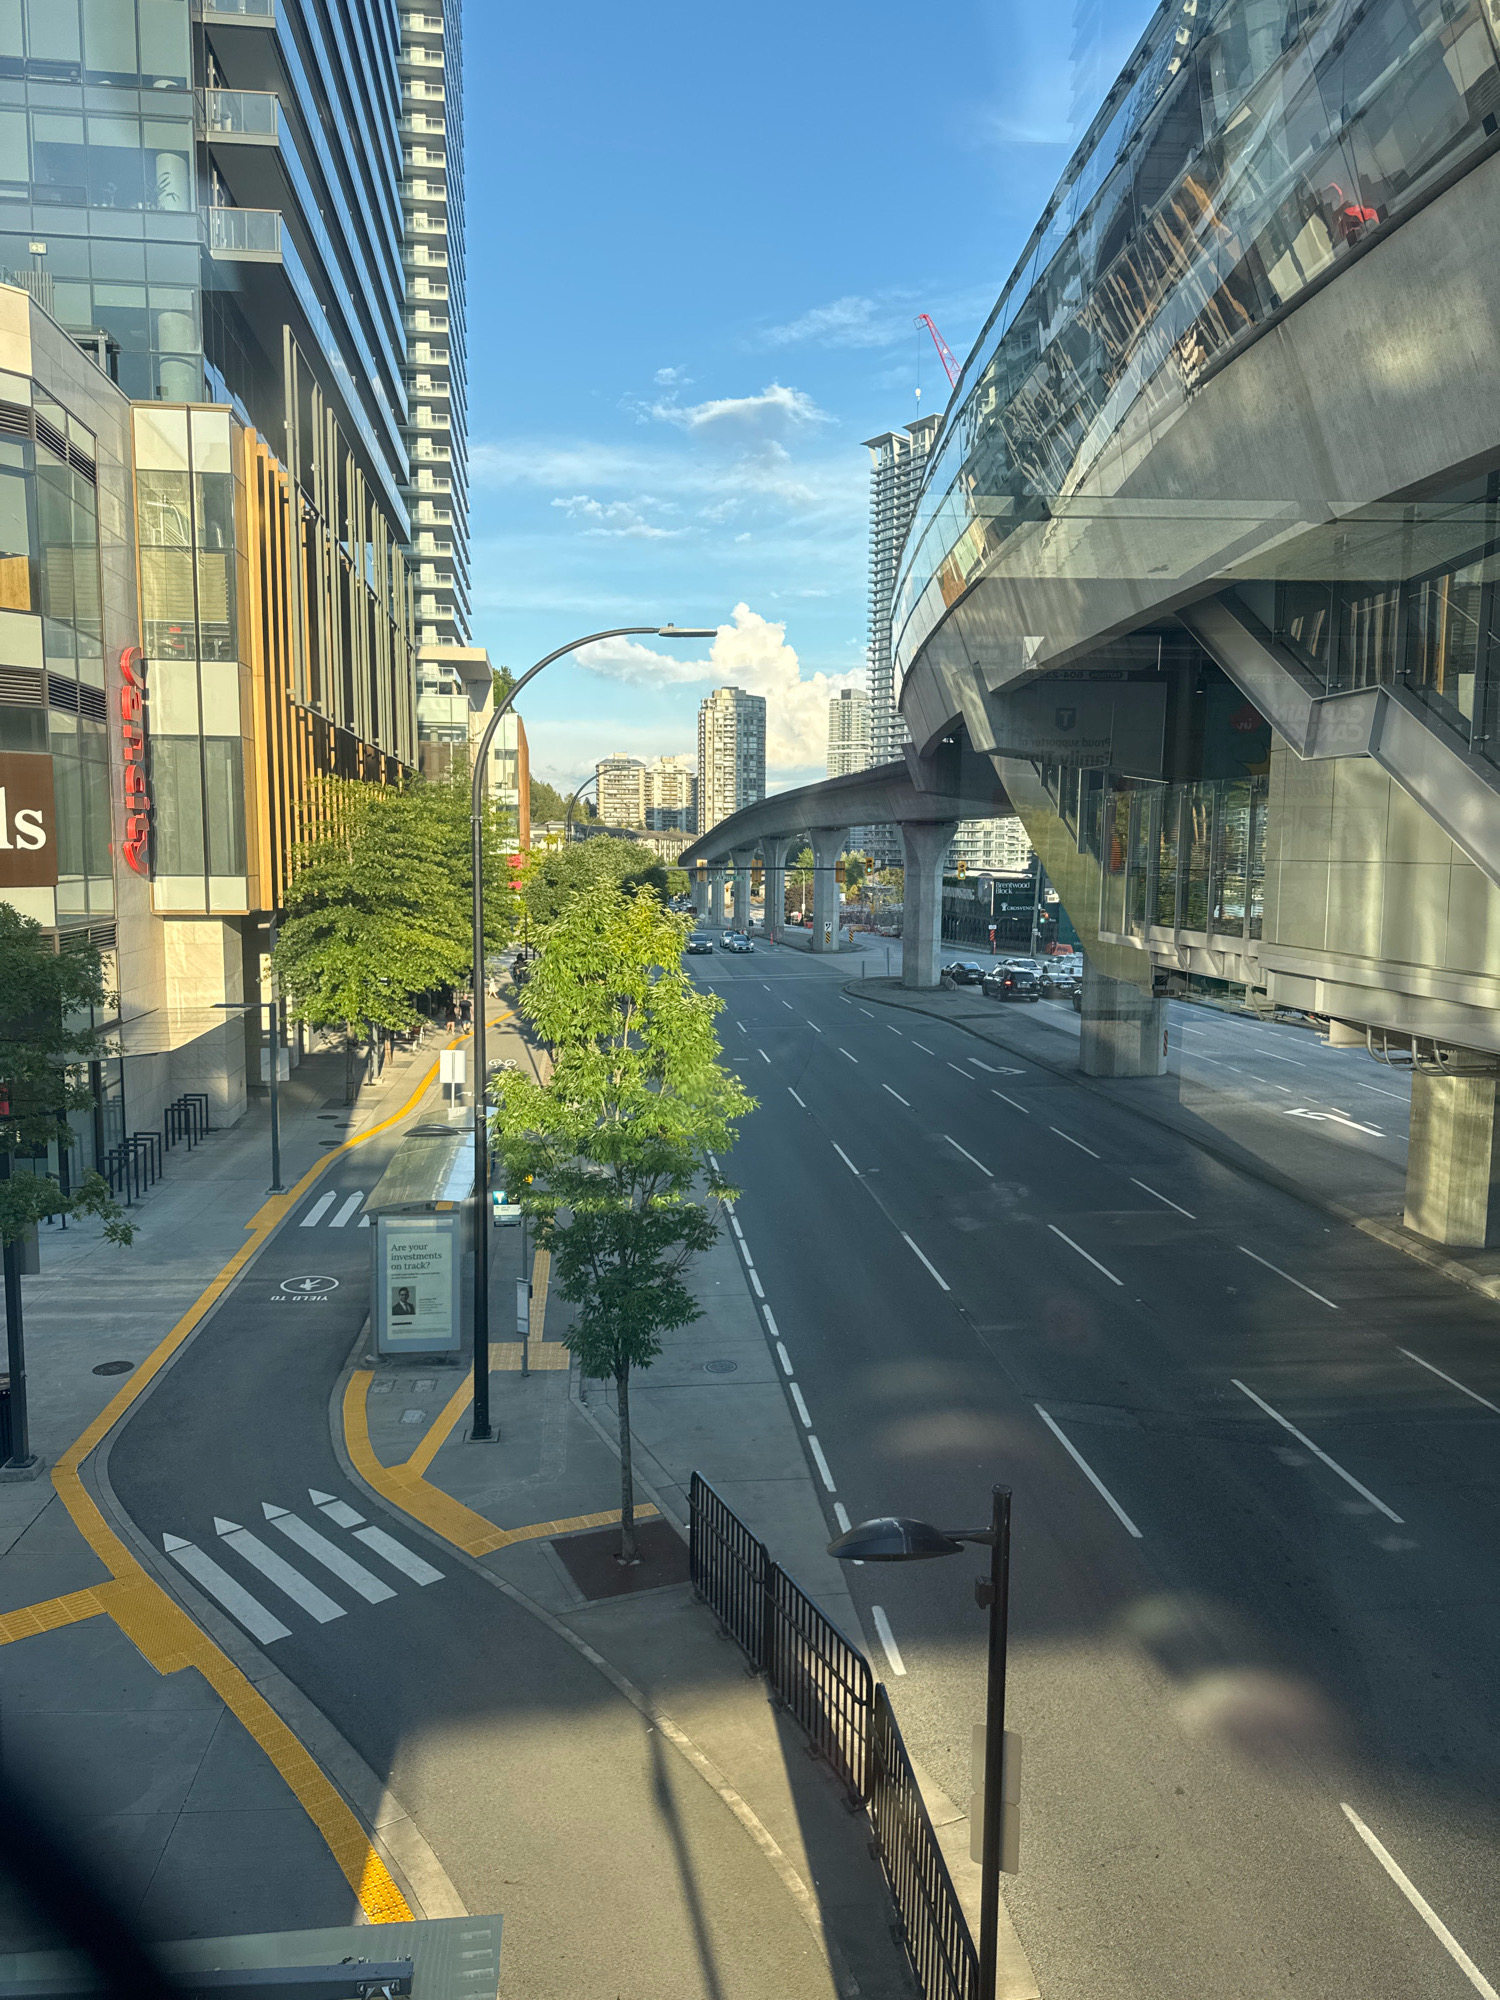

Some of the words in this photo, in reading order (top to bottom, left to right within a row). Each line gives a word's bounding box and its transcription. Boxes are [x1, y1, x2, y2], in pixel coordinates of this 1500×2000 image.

[391, 1244, 407, 1252] Are
[408, 1243, 428, 1253] your
[391, 1252, 442, 1261] investments
[404, 1261, 430, 1270] track?
